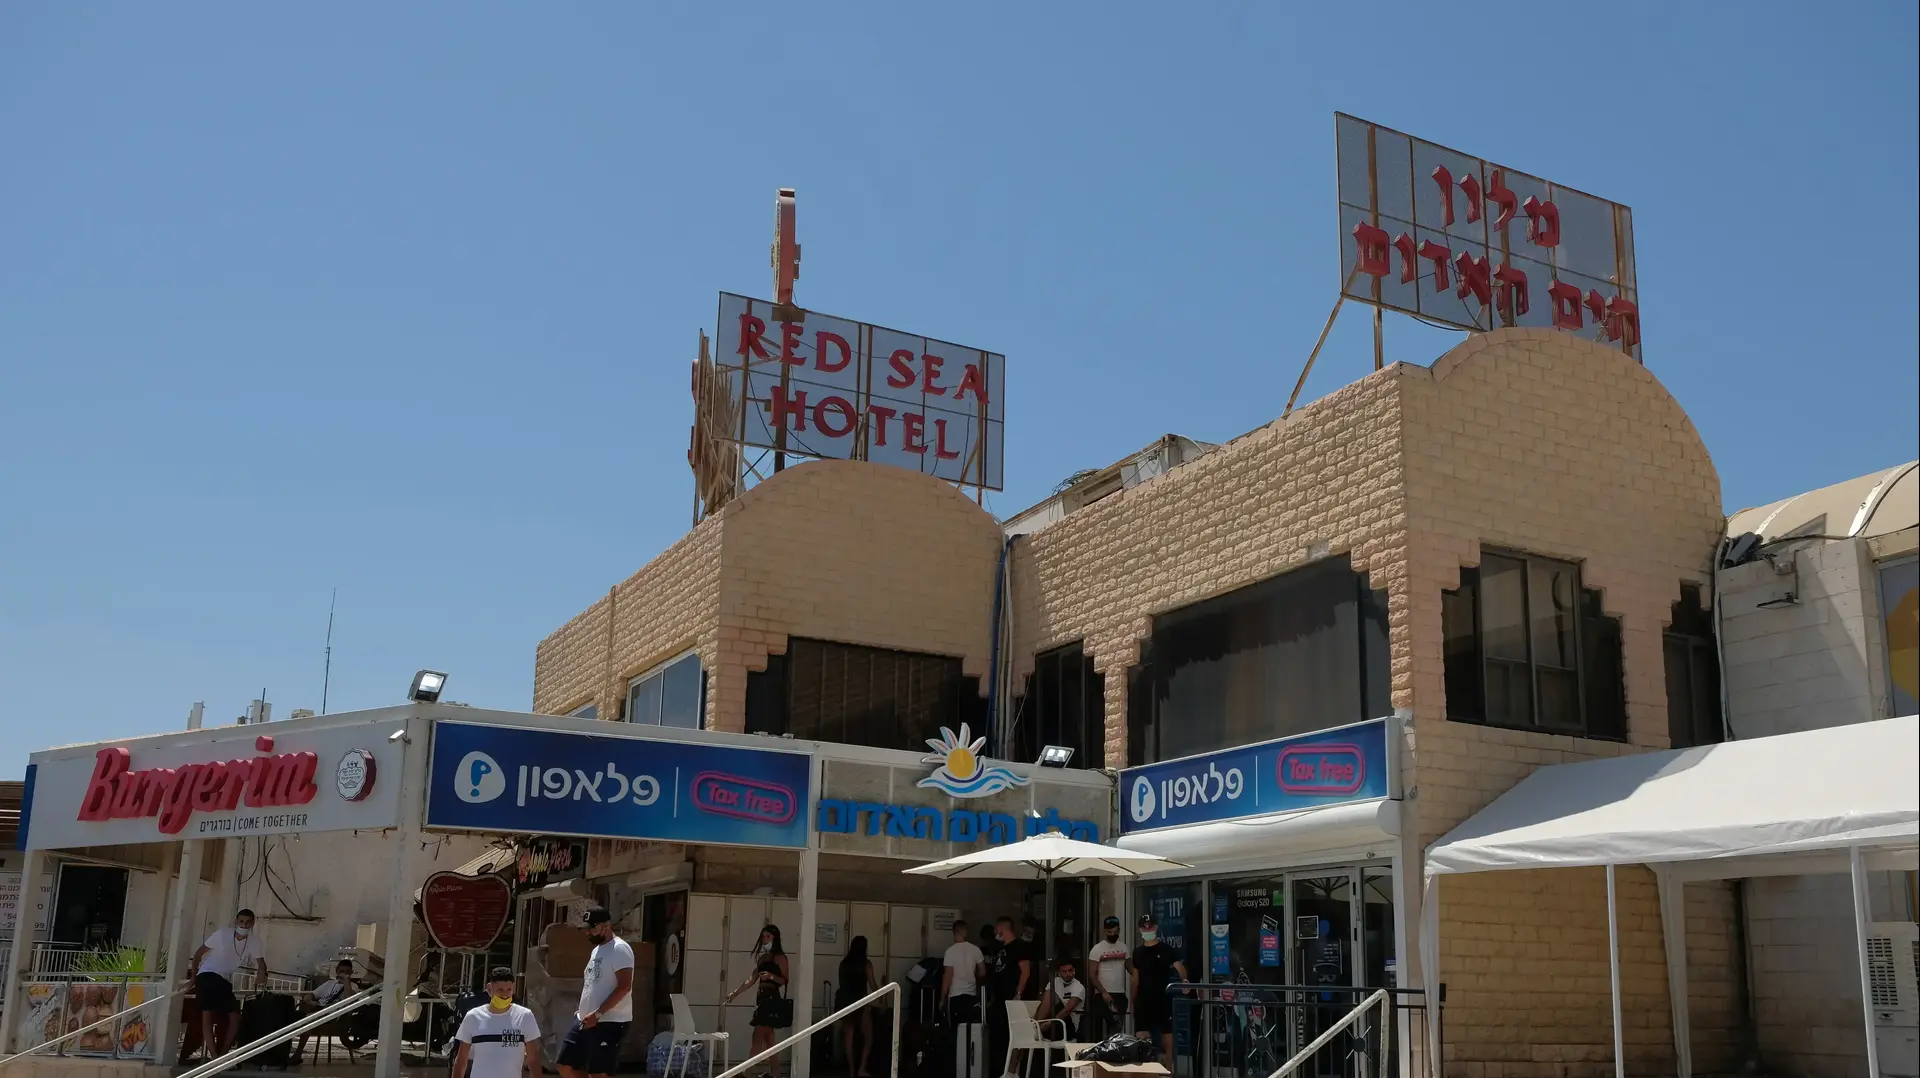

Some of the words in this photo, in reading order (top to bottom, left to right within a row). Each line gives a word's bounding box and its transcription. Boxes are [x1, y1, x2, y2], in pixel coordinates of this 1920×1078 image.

[1432, 164, 1560, 248] מלון
[1352, 220, 1530, 318] האדום
[1548, 278, 1640, 346] הים
[736, 313, 852, 373] RED
[887, 349, 990, 405] SEA
[769, 386, 960, 460] HOTEL
[77, 736, 318, 834] Burgerim
[517, 762, 660, 807] פלאפון
[1161, 761, 1243, 819] פלאפון
[1288, 759, 1315, 780] Tax
[1319, 757, 1355, 781] free
[708, 782, 740, 806] Tax
[745, 788, 785, 815] free
[817, 799, 944, 841] האדום
[200, 819, 232, 832] בורגרים
[238, 816, 260, 830] COME
[263, 814, 308, 828] TOGETHER
[949, 809, 1017, 844] הים
[1236, 888, 1267, 898] SAMSUNG
[1236, 899, 1259, 908] Galaxy
[1259, 898, 1270, 907] S20
